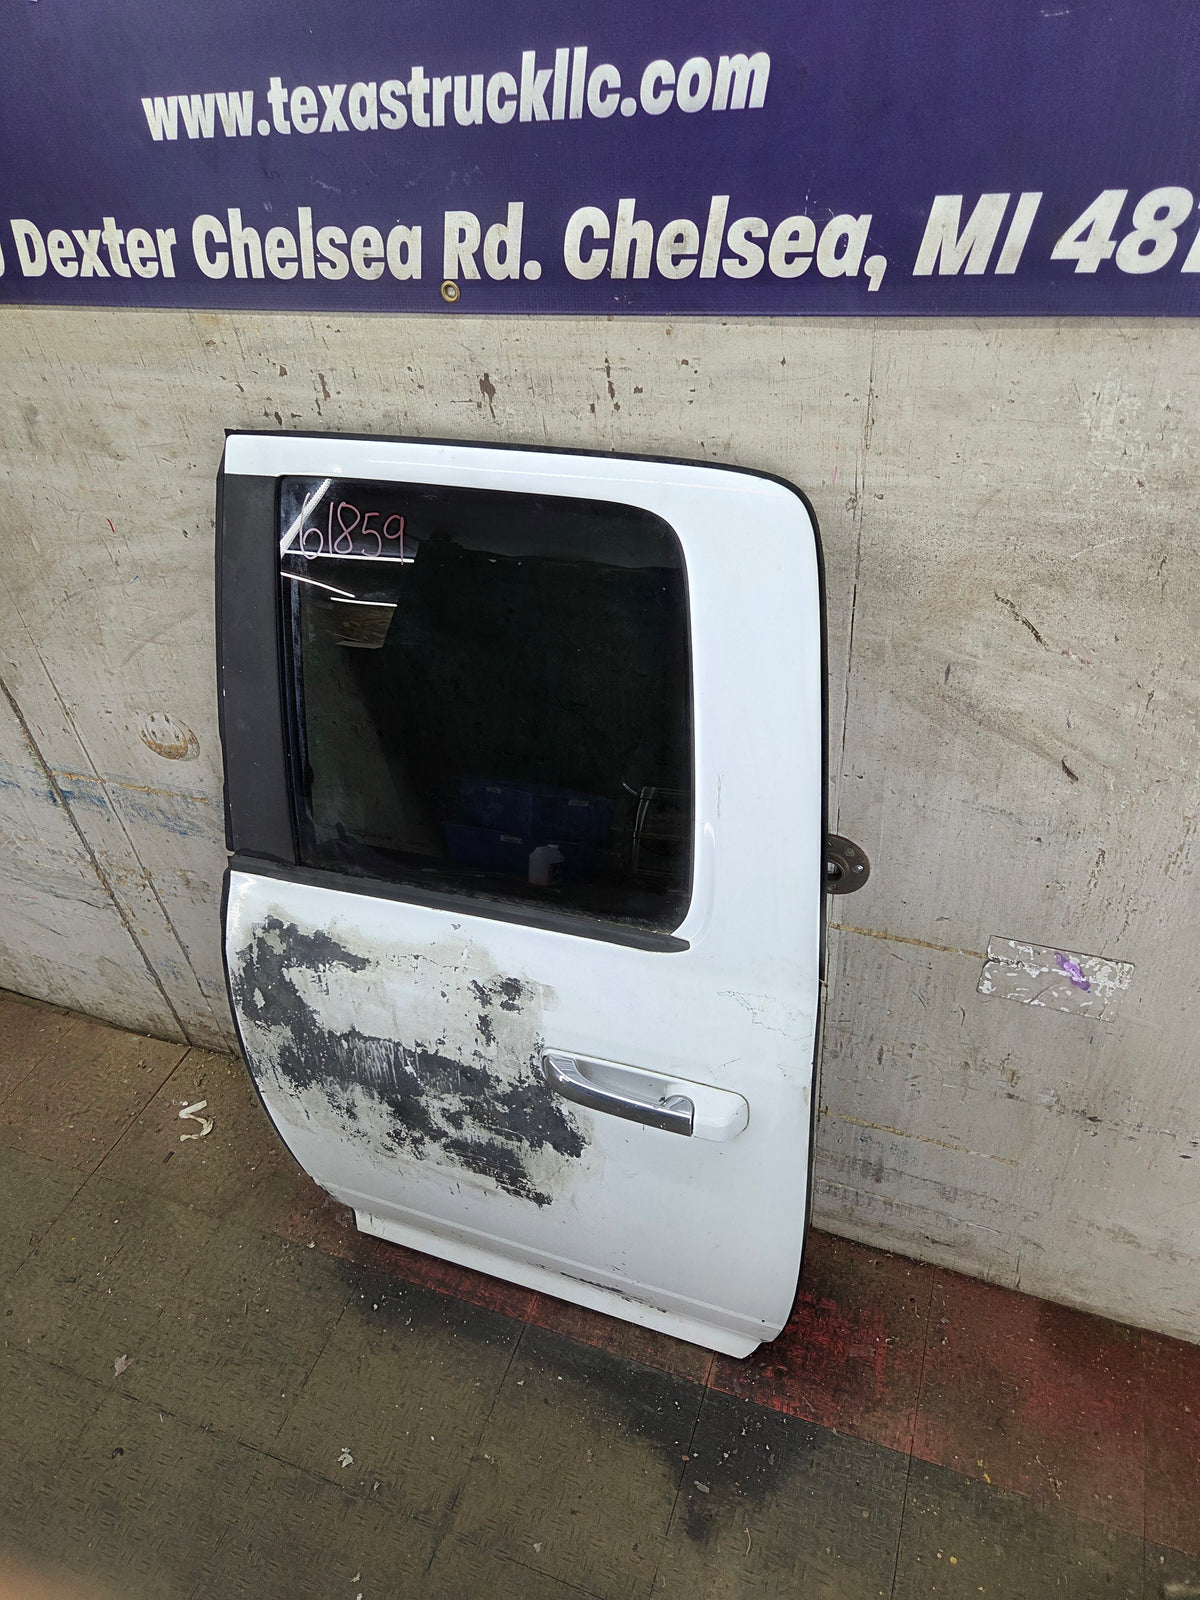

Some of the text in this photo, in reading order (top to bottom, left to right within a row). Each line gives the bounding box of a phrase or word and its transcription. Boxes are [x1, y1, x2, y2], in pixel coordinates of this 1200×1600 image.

[141, 46, 770, 141] www.texastruckllc.com
[10, 217, 177, 278] Dexter
[192, 207, 422, 281] Chelsea
[444, 202, 542, 281] Rd.
[564, 195, 888, 292] Chelsea,
[913, 192, 1043, 275] MI
[299, 492, 405, 566] 61859
